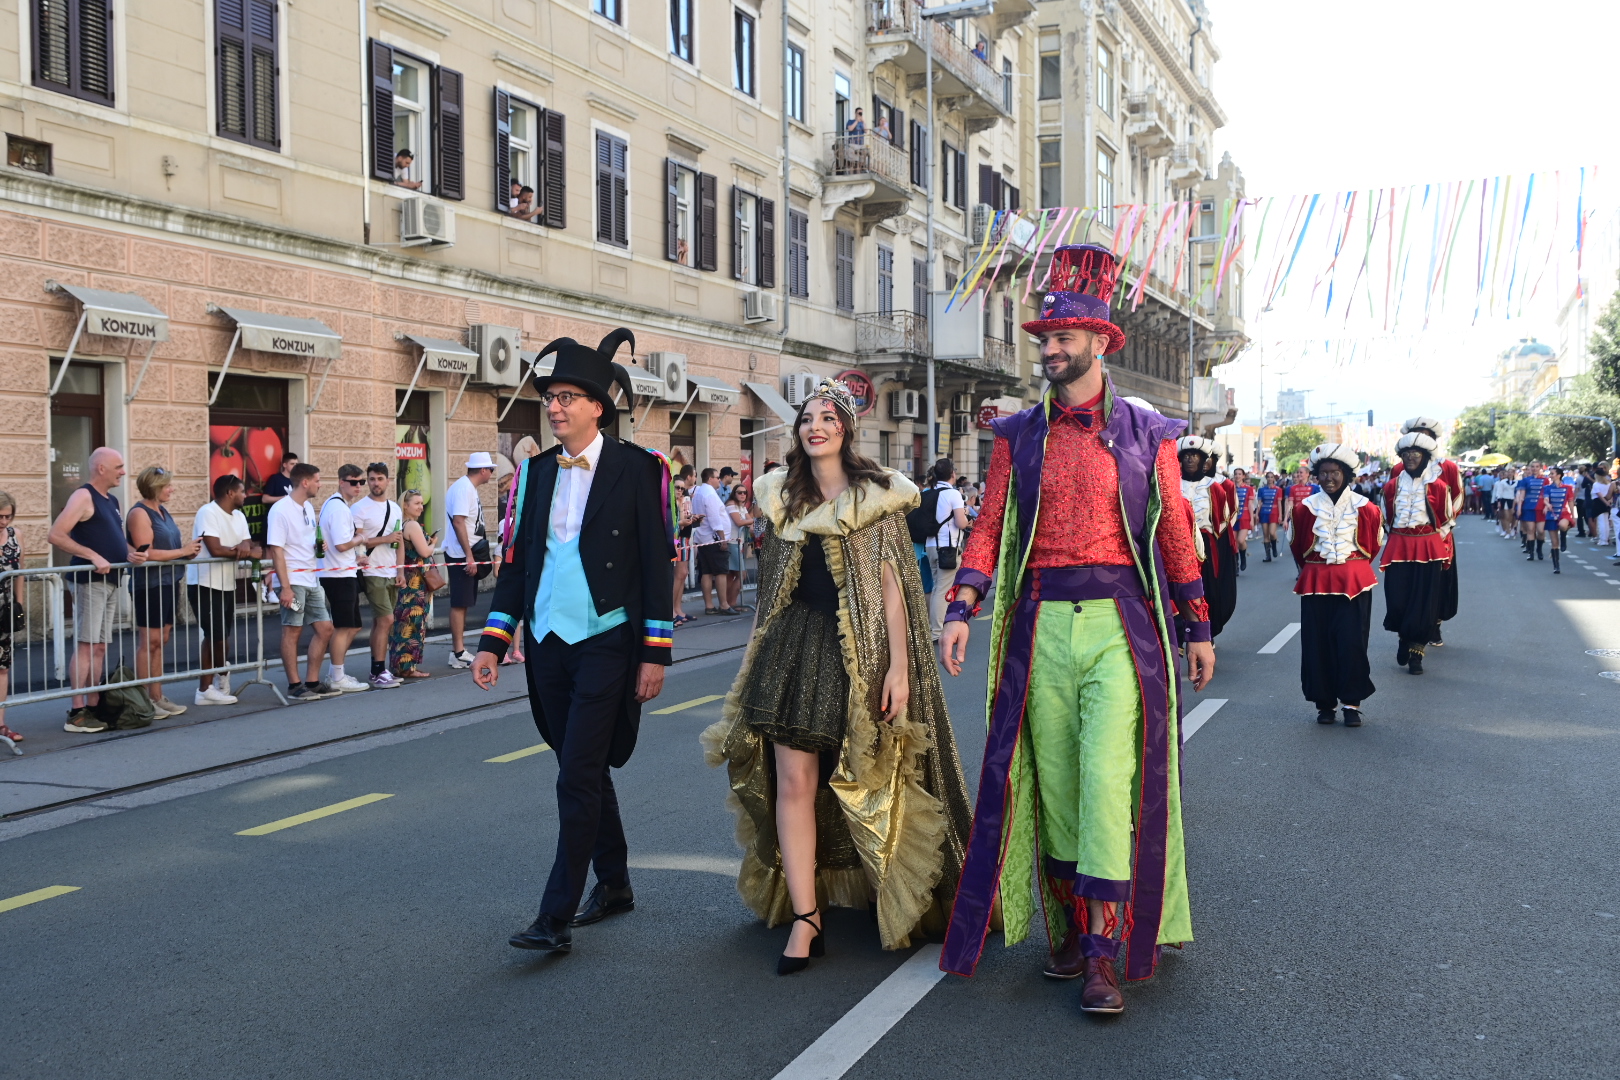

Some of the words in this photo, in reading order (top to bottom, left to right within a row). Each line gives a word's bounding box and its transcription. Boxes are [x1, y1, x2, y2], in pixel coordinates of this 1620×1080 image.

[101, 317, 155, 337] KONZUM
[272, 337, 315, 354] KONZUM
[437, 357, 468, 371] KONZUM
[636, 384, 658, 395] KONZUM
[710, 393, 729, 403] KONZUM
[396, 446, 423, 458] ONZUM
[62, 464, 80, 472] izlaz
[740, 463, 750, 471] ZUM
